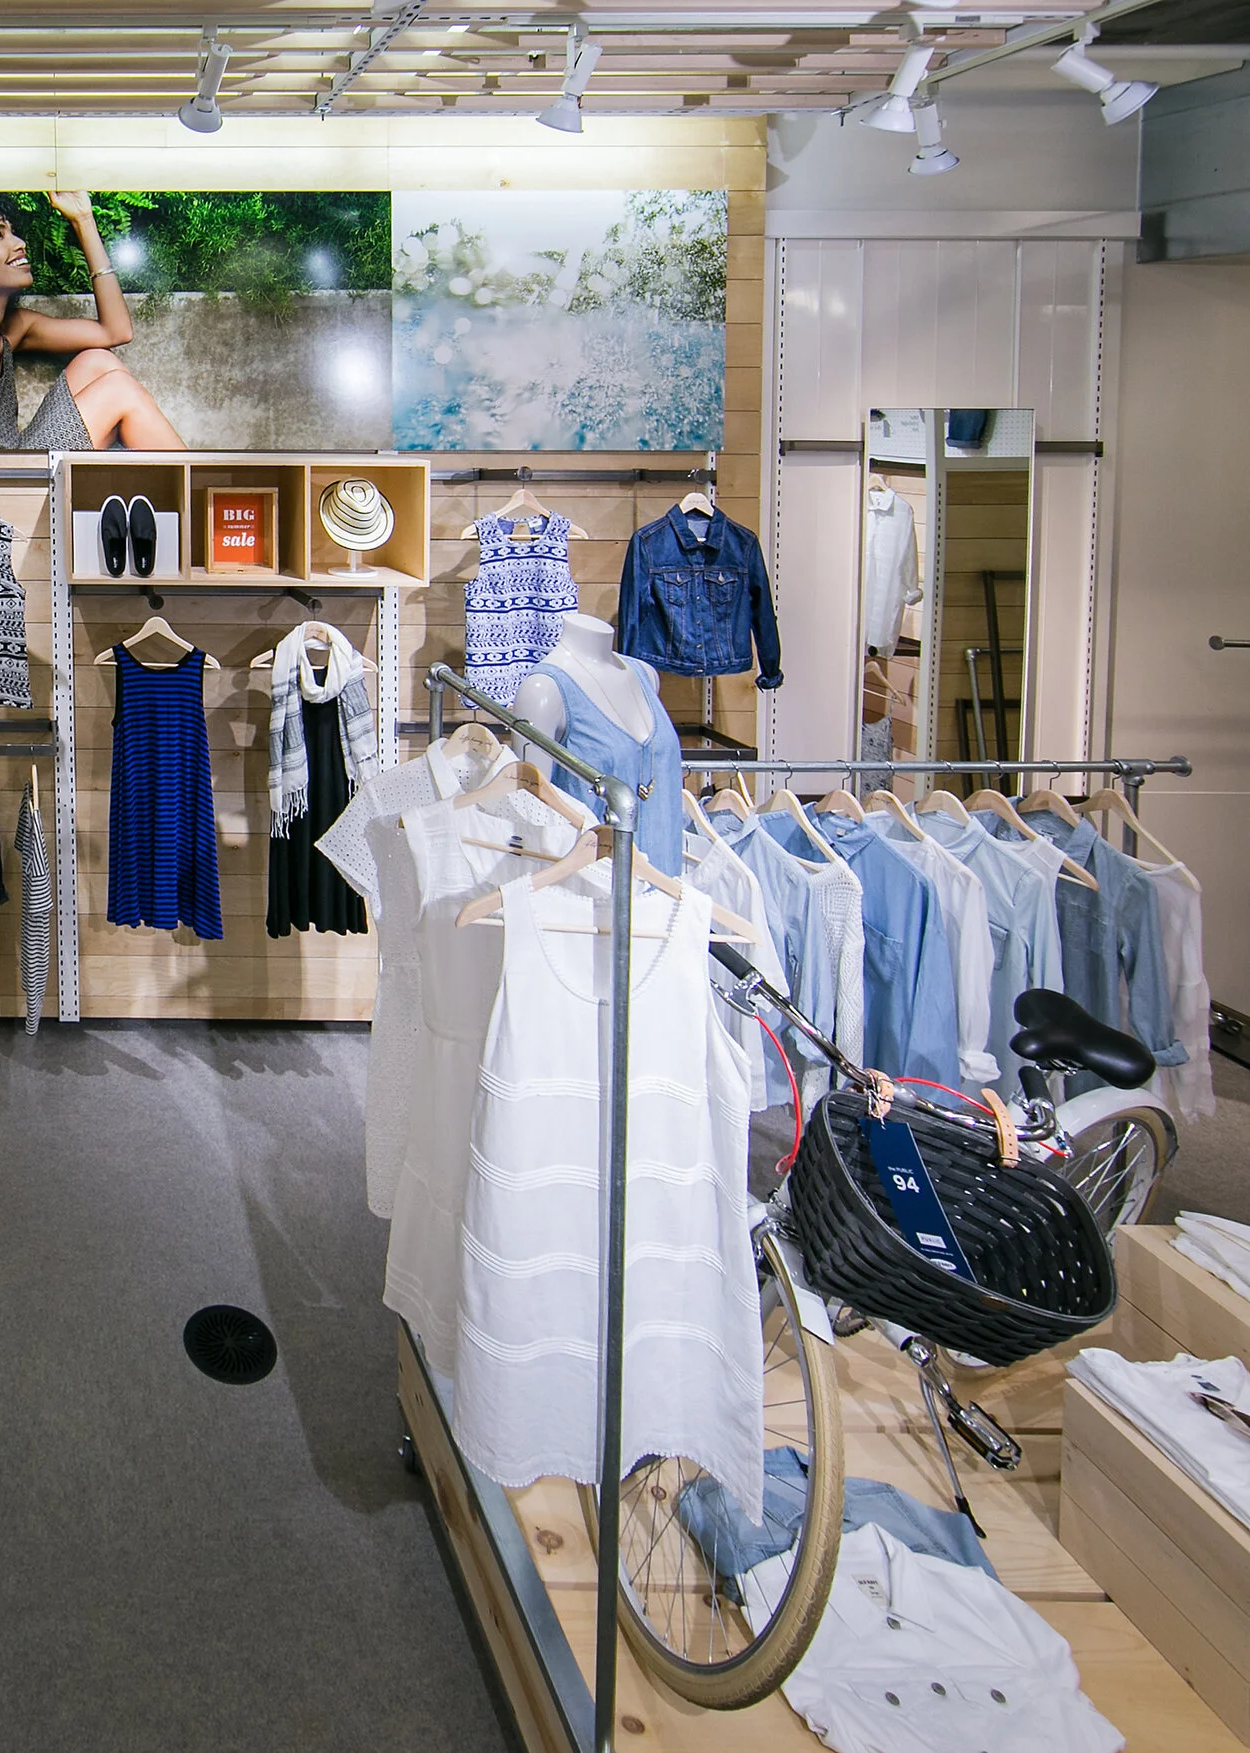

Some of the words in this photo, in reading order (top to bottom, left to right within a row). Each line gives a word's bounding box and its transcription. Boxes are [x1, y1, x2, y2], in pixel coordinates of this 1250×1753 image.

[223, 509, 255, 521] BIG
[222, 531, 256, 547] sale
[892, 1174, 920, 1193] 94
